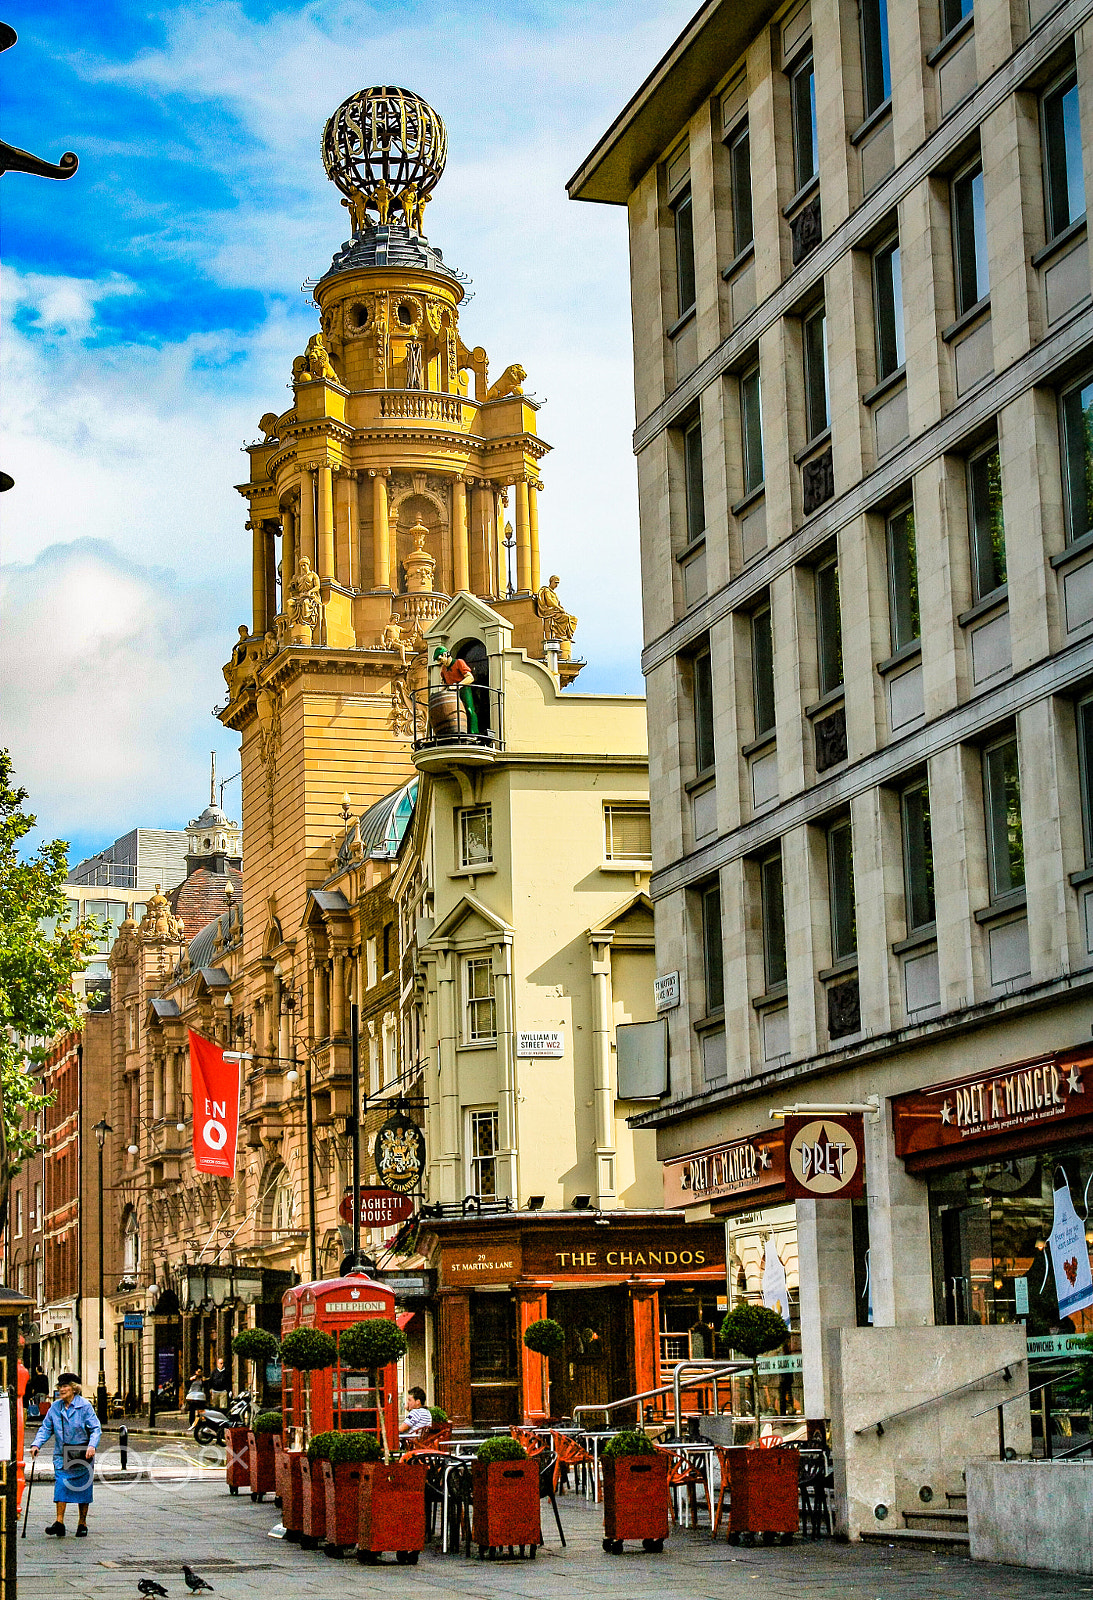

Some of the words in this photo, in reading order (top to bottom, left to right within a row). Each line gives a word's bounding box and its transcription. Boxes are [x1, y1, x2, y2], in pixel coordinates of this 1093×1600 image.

[521, 1033, 549, 1041] WILLIAM
[552, 1033, 558, 1041] IV
[956, 1083, 984, 1127] PRET
[992, 1080, 999, 1119] A
[1005, 1065, 1061, 1115] MANGER
[205, 1096, 226, 1119] EN
[203, 1118, 228, 1150] O
[802, 1141, 846, 1175] PRET
[689, 1156, 708, 1191] PRET
[712, 1155, 719, 1187] A
[721, 1144, 757, 1184] MANGER
[382, 1174, 394, 1188] THE
[392, 1172, 420, 1192] CHANDOS
[350, 1197, 402, 1210] SAGHETTI
[360, 1210, 392, 1222] HOUSE
[478, 1254, 486, 1262] 29
[495, 1261, 513, 1269] LANE
[556, 1252, 597, 1266] THE
[606, 1250, 706, 1266] CHANDOS
[329, 1302, 383, 1311] TELEPHONE
[777, 1359, 790, 1370] SALADS
